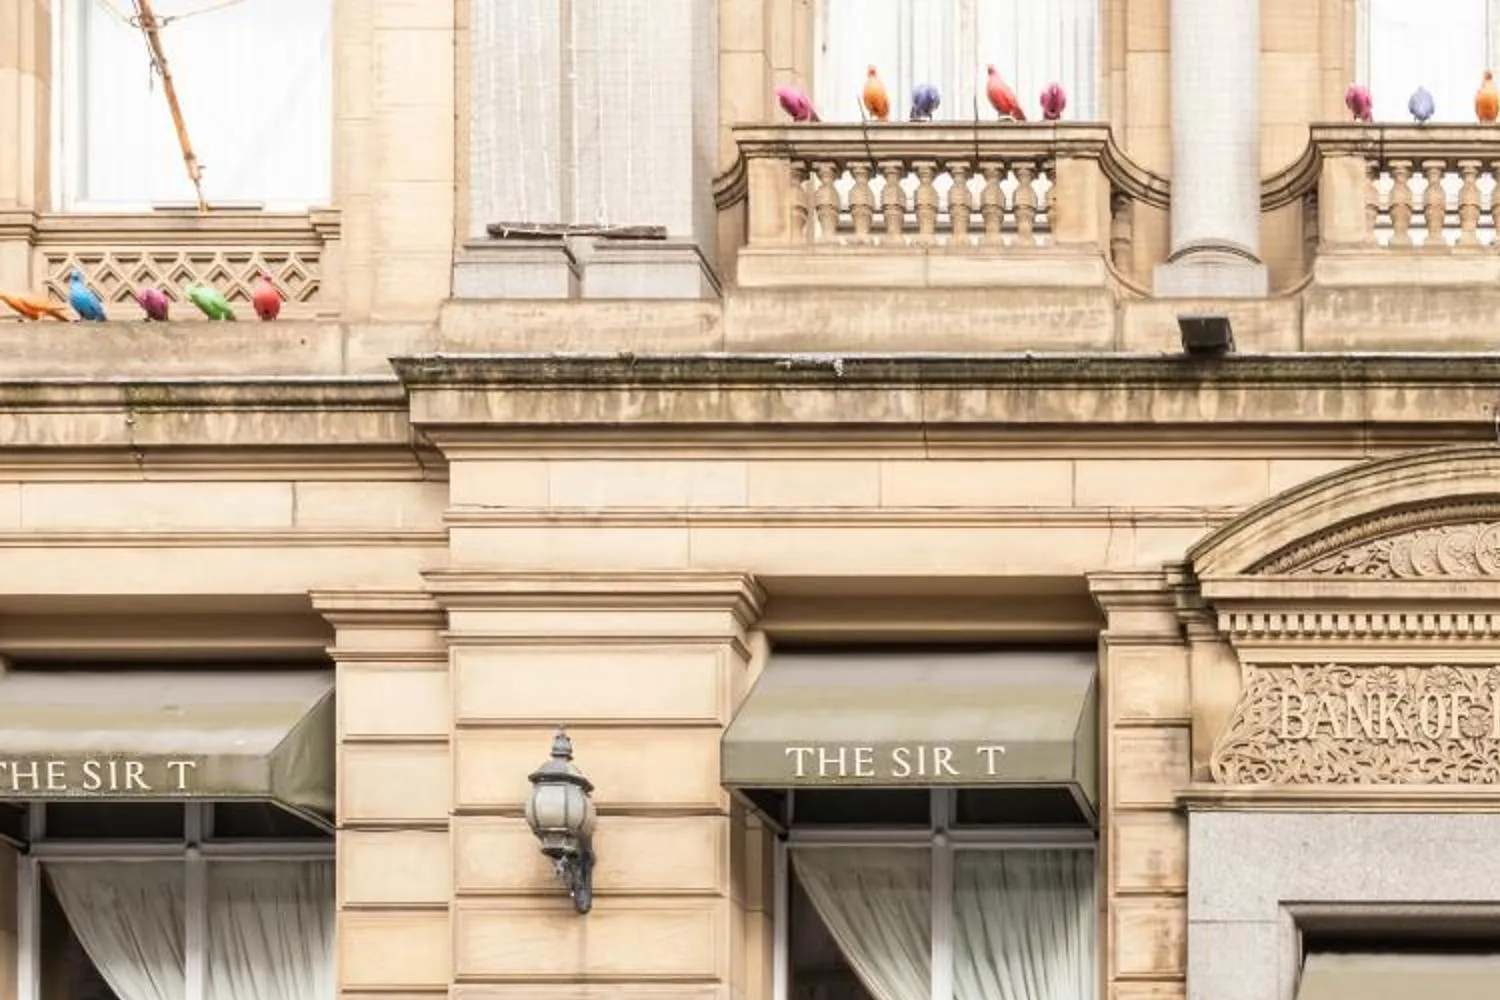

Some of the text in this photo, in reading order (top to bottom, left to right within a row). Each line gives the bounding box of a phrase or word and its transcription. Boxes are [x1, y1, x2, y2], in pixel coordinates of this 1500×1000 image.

[1278, 692, 1410, 741] BANK
[1419, 692, 1474, 741] OF
[82, 761, 152, 791] SIR
[167, 761, 197, 790] T
[785, 746, 1007, 778] THE SIR T
